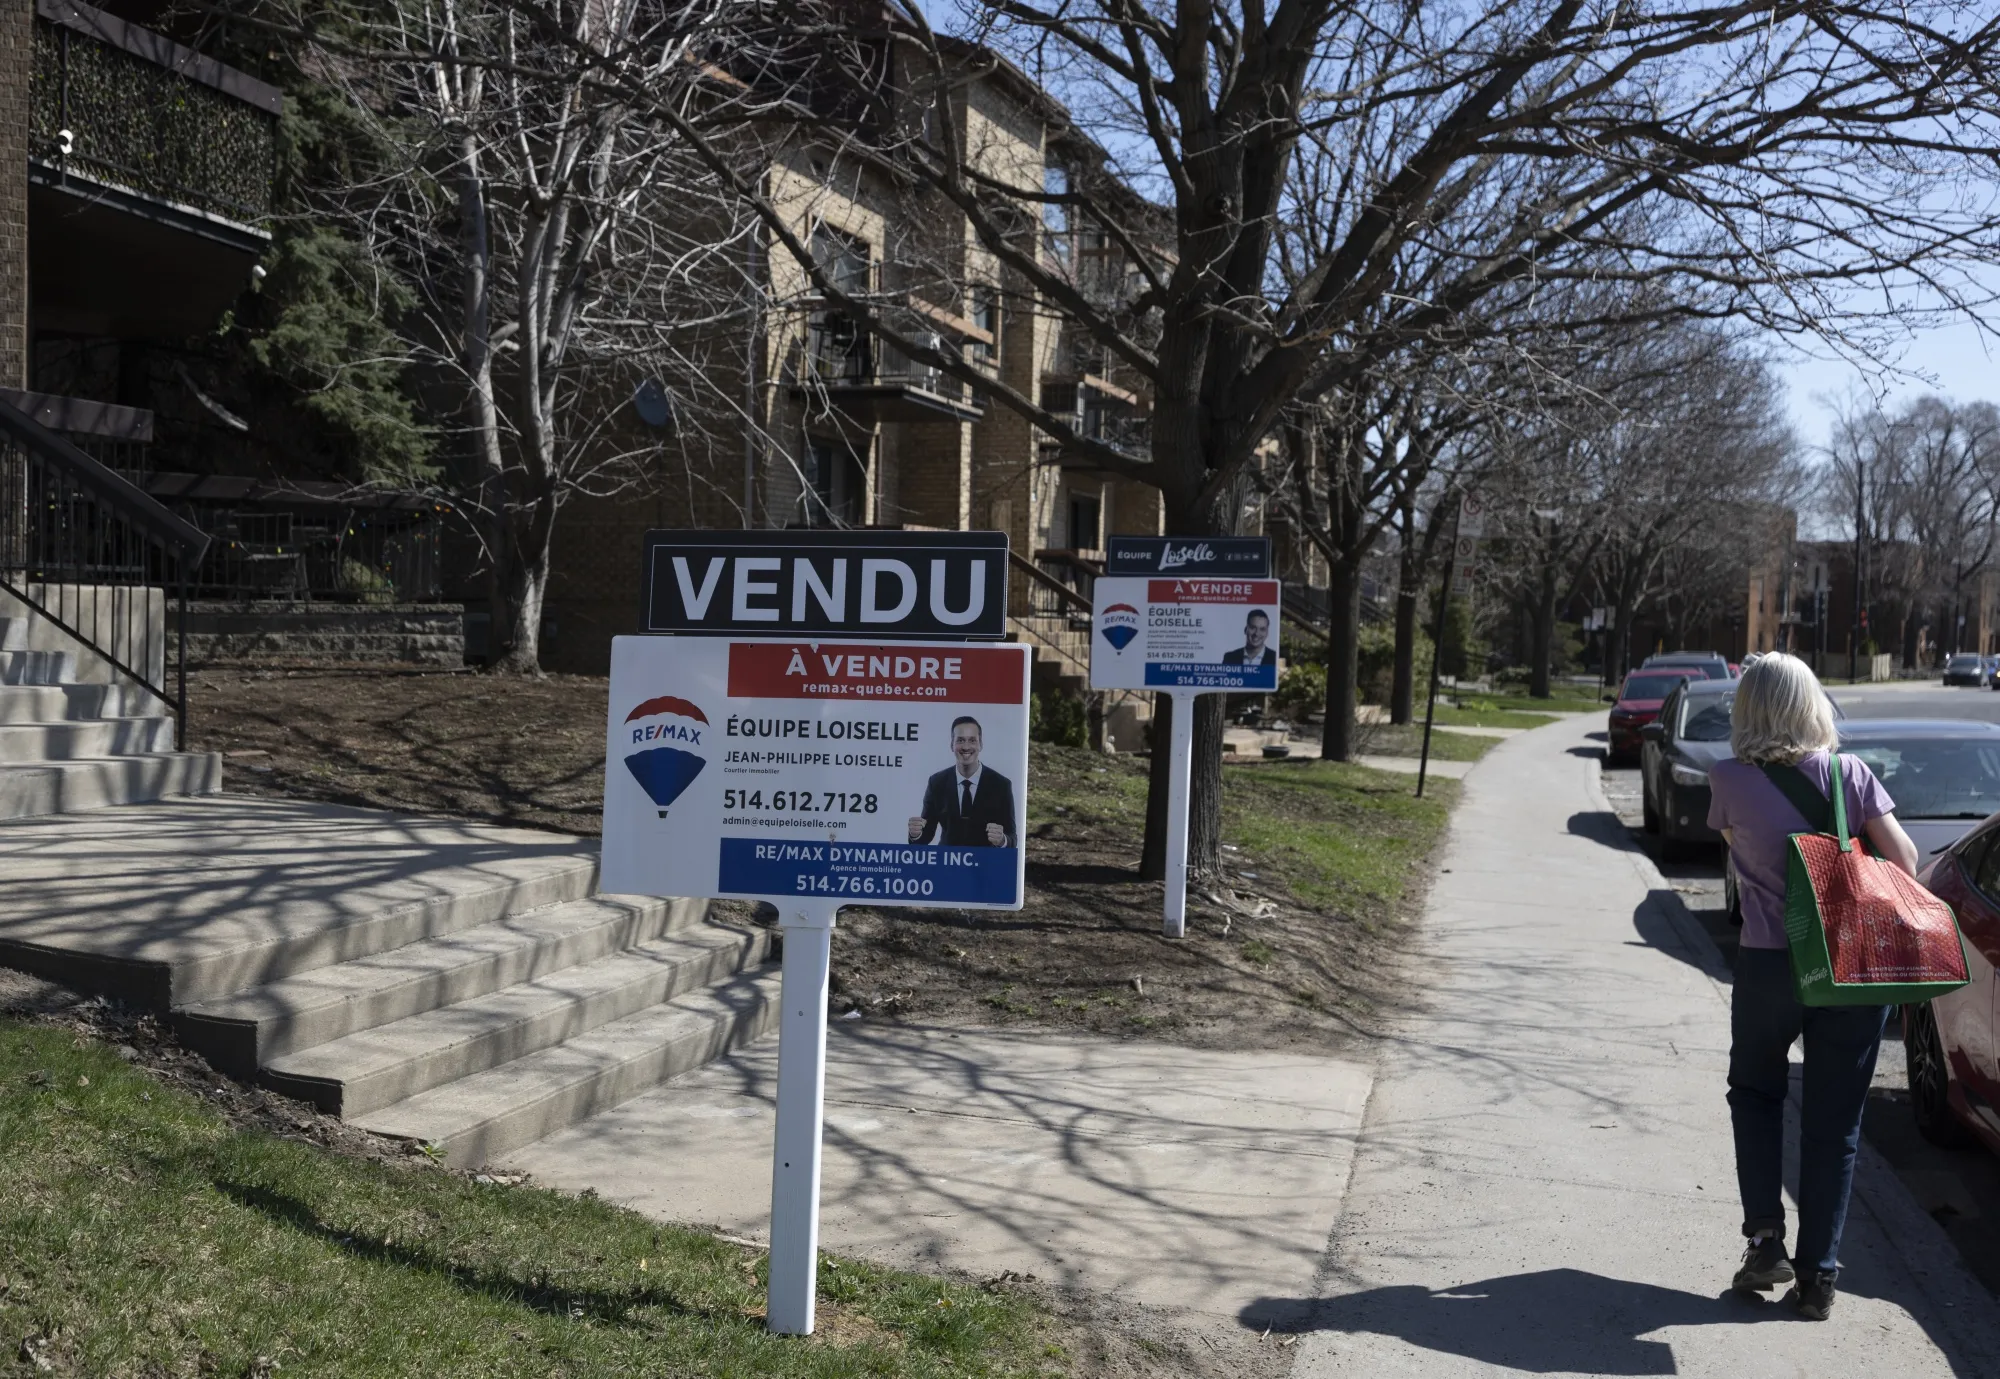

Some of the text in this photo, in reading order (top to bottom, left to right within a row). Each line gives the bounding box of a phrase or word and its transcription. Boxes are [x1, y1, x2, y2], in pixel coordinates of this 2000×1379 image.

[1117, 542, 1218, 571] ÉQUIPE Loiselle
[672, 556, 987, 626] VENDU
[1174, 580, 1253, 595] À VENDRE
[1148, 605, 1191, 617] ÉQUIPE
[1104, 615, 1136, 625] RE/MAX
[1148, 618, 1203, 628] LOISELLE
[785, 648, 963, 680] À VENDRE
[1160, 664, 1261, 674] RE/MAX DYNAMIQUE INC.
[1177, 676, 1244, 686] 514 766-1000
[802, 683, 947, 697] remax-quebec.com
[632, 724, 702, 746] RE/MAX
[726, 714, 919, 742] ÉQUIPE LOISELLE
[724, 751, 903, 768] JEAN-PHILIPPE LOISELLE
[723, 789, 878, 814] 514.612.7128
[722, 817, 847, 829] admin@equipeloiselle.com
[755, 845, 979, 867] RE/MAX DYNAMIQUE INC.
[830, 864, 857, 873] Agence
[796, 875, 934, 896] 514.766.1000
